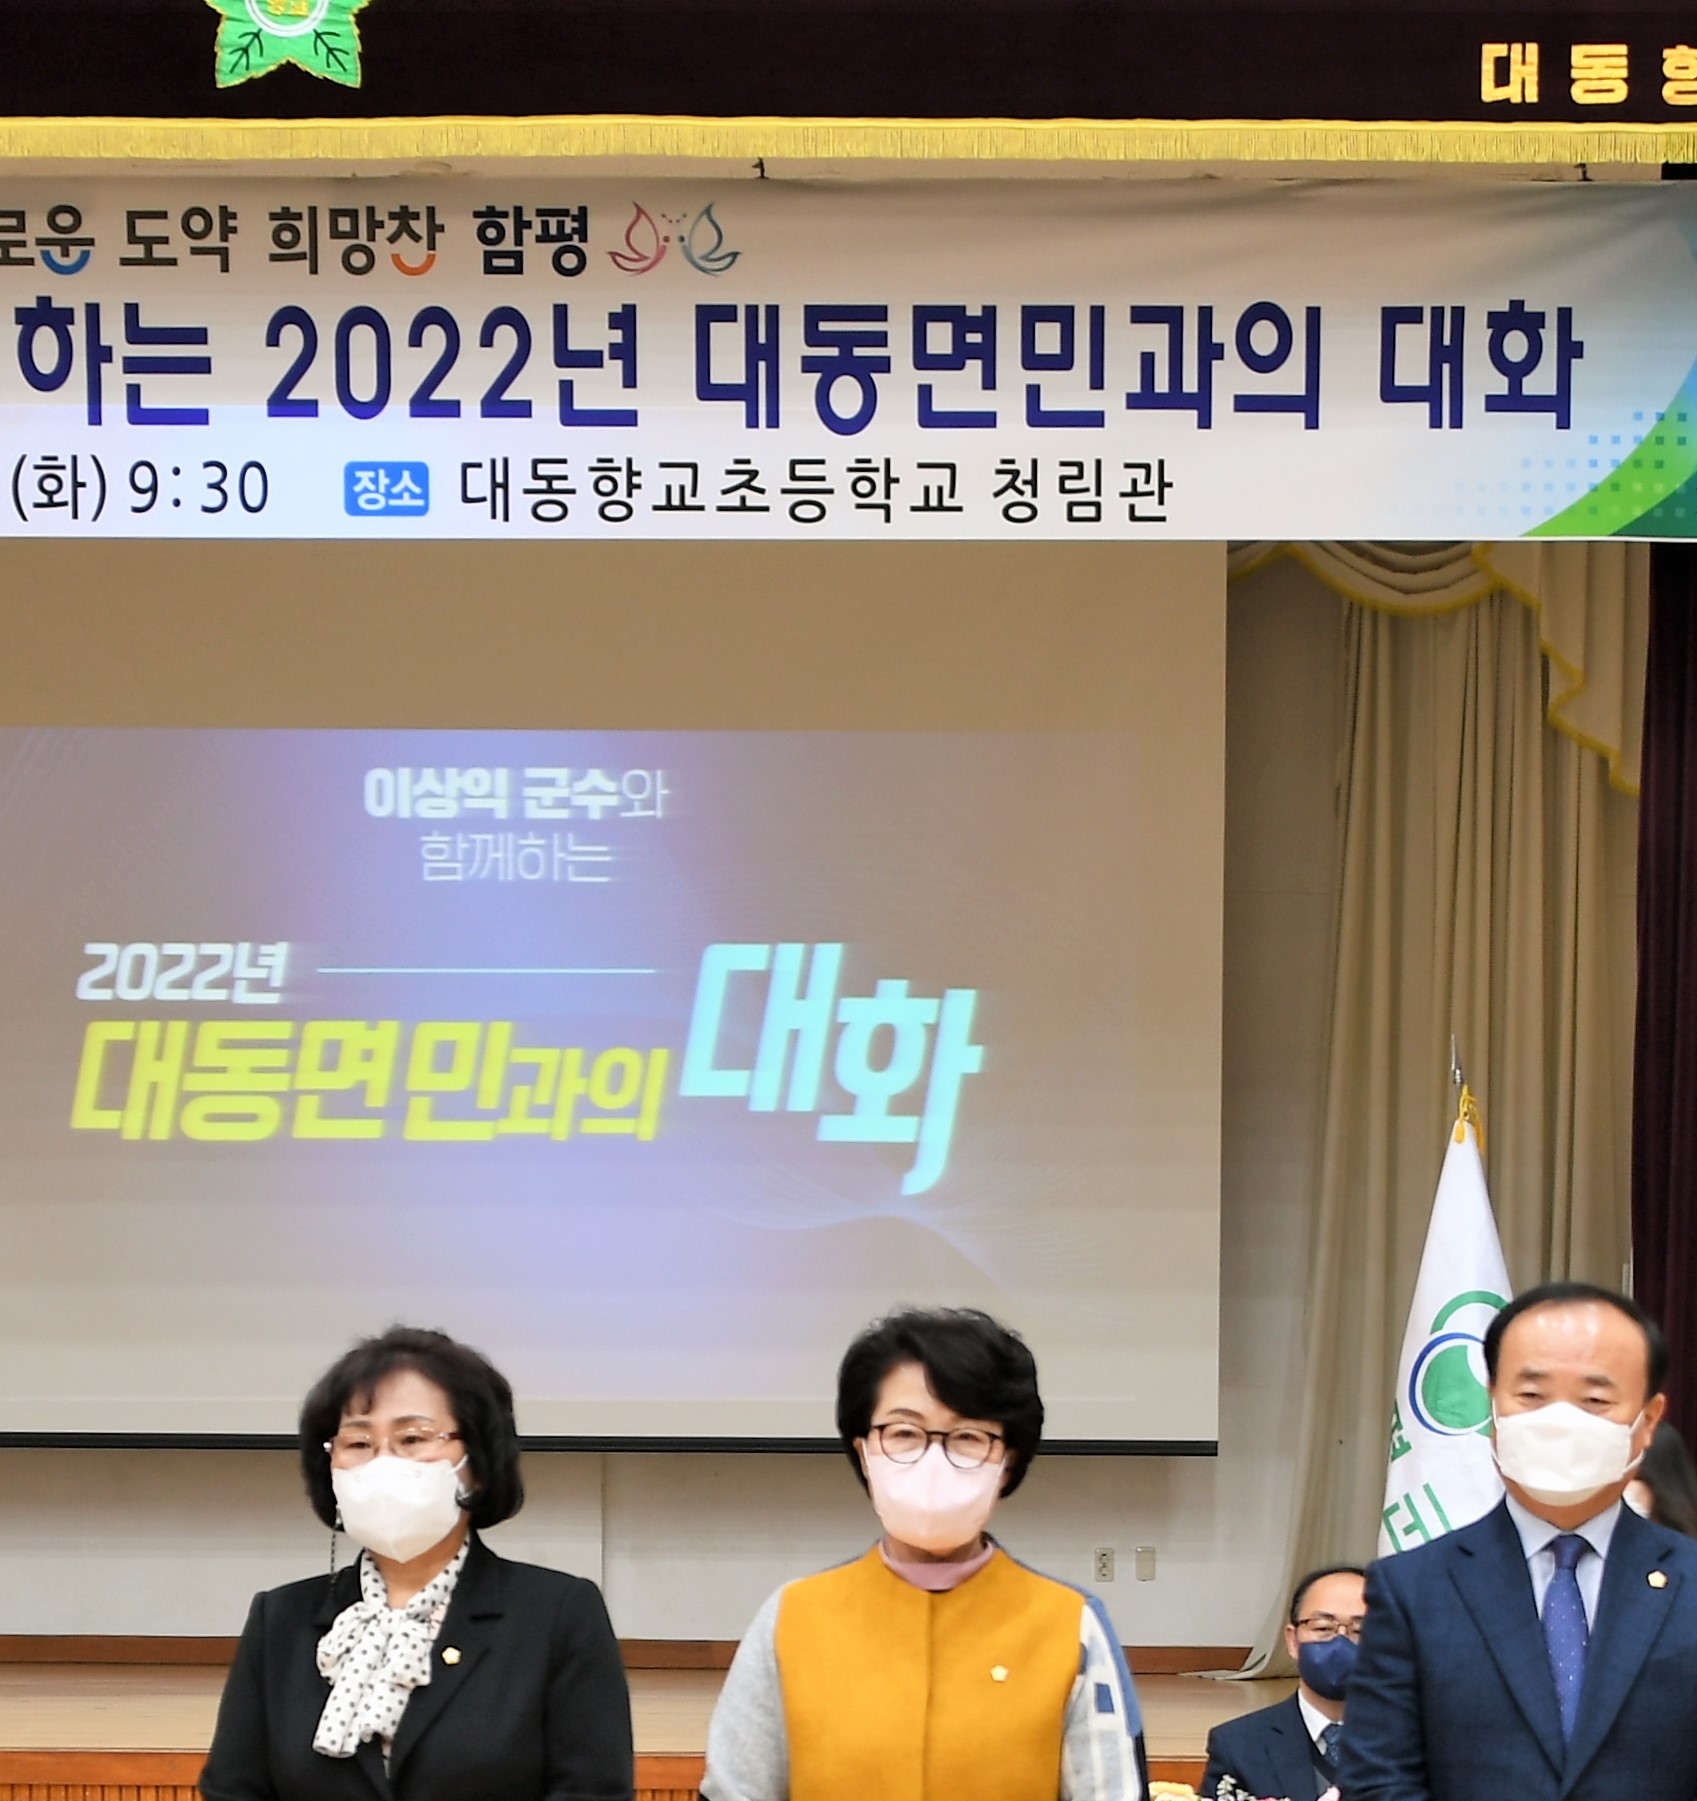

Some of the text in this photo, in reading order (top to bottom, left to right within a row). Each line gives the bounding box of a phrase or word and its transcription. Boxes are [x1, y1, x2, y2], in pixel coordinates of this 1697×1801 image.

[119, 204, 238, 273] 도약
[268, 204, 445, 276] 희망찬
[472, 204, 589, 278] 함평
[265, 302, 638, 427] 2022년
[694, 301, 1322, 436] 대동면민과의
[1379, 298, 1585, 430] 대화
[129, 460, 268, 514] 9:30
[352, 456, 1174, 524] 장소 대동향교초등학교 청림관
[364, 766, 669, 821] 이상익 군수와
[419, 831, 613, 883] 함께하는
[76, 941, 290, 1005] 2022년
[678, 942, 985, 1196] 대화
